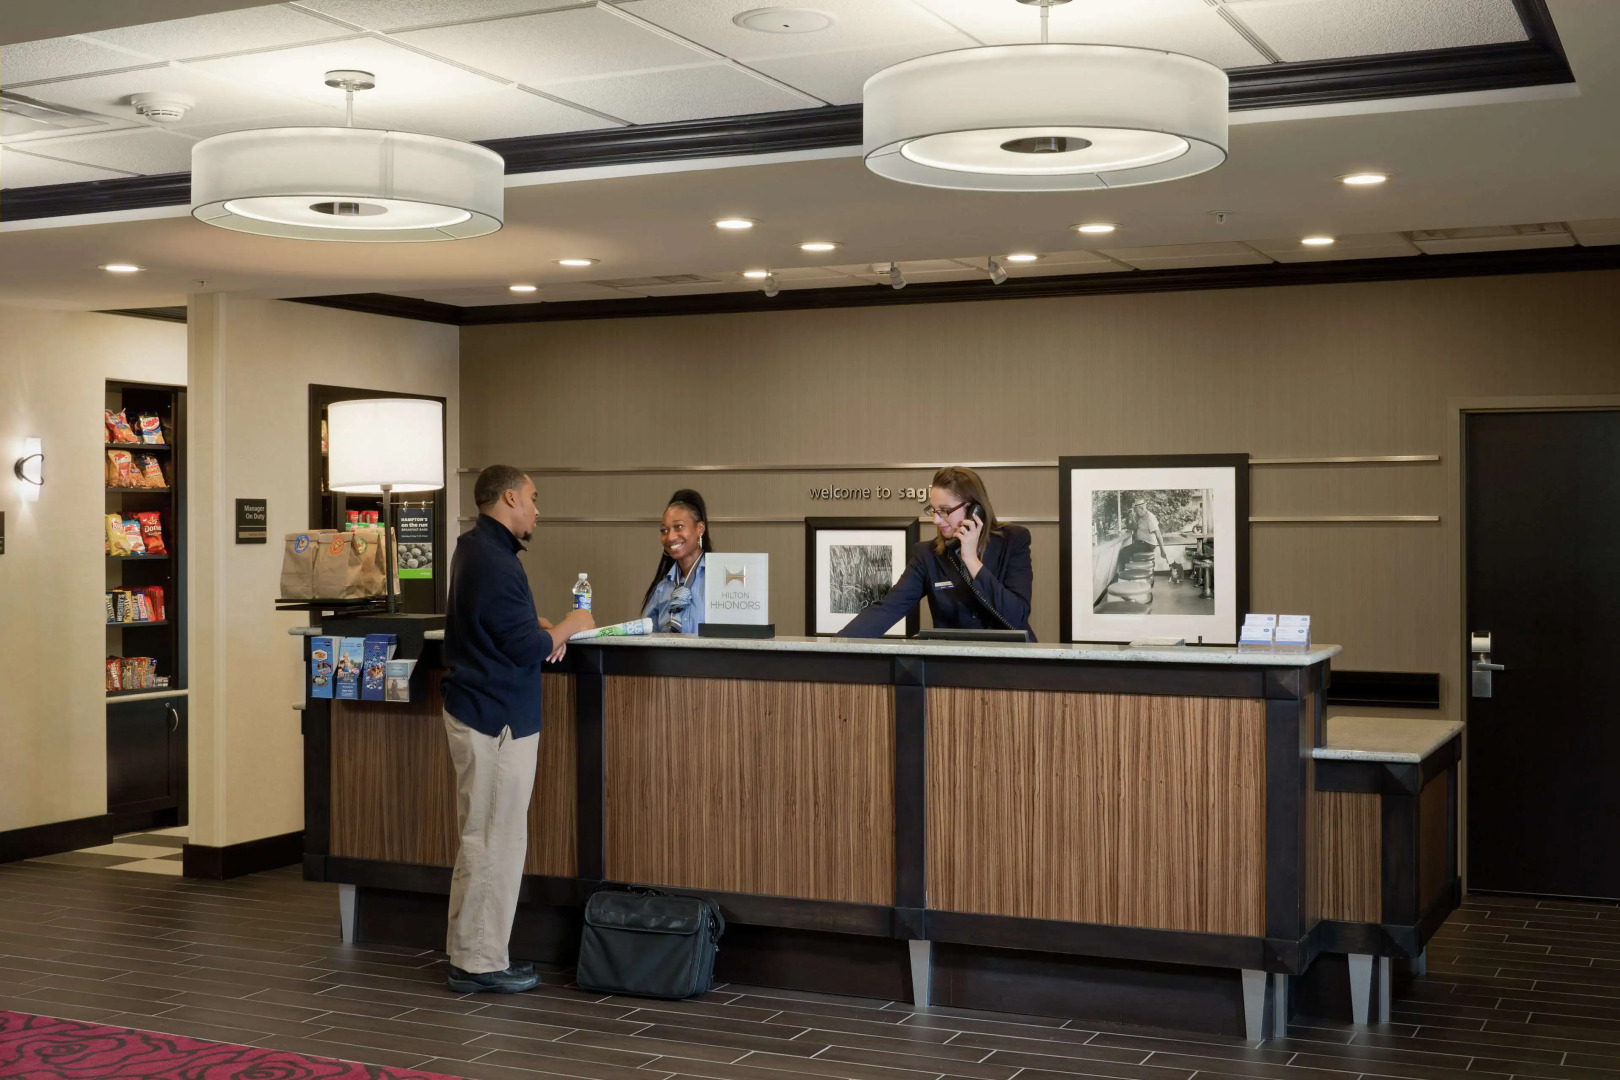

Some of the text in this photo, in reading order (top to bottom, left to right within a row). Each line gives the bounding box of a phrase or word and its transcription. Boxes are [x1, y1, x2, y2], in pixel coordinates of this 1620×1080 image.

[809, 484, 872, 499] welcome
[875, 485, 892, 499] to
[244, 505, 265, 513] Manager
[253, 513, 265, 521] Duty
[721, 591, 750, 599] HILTON
[710, 600, 761, 610] HHONORS
